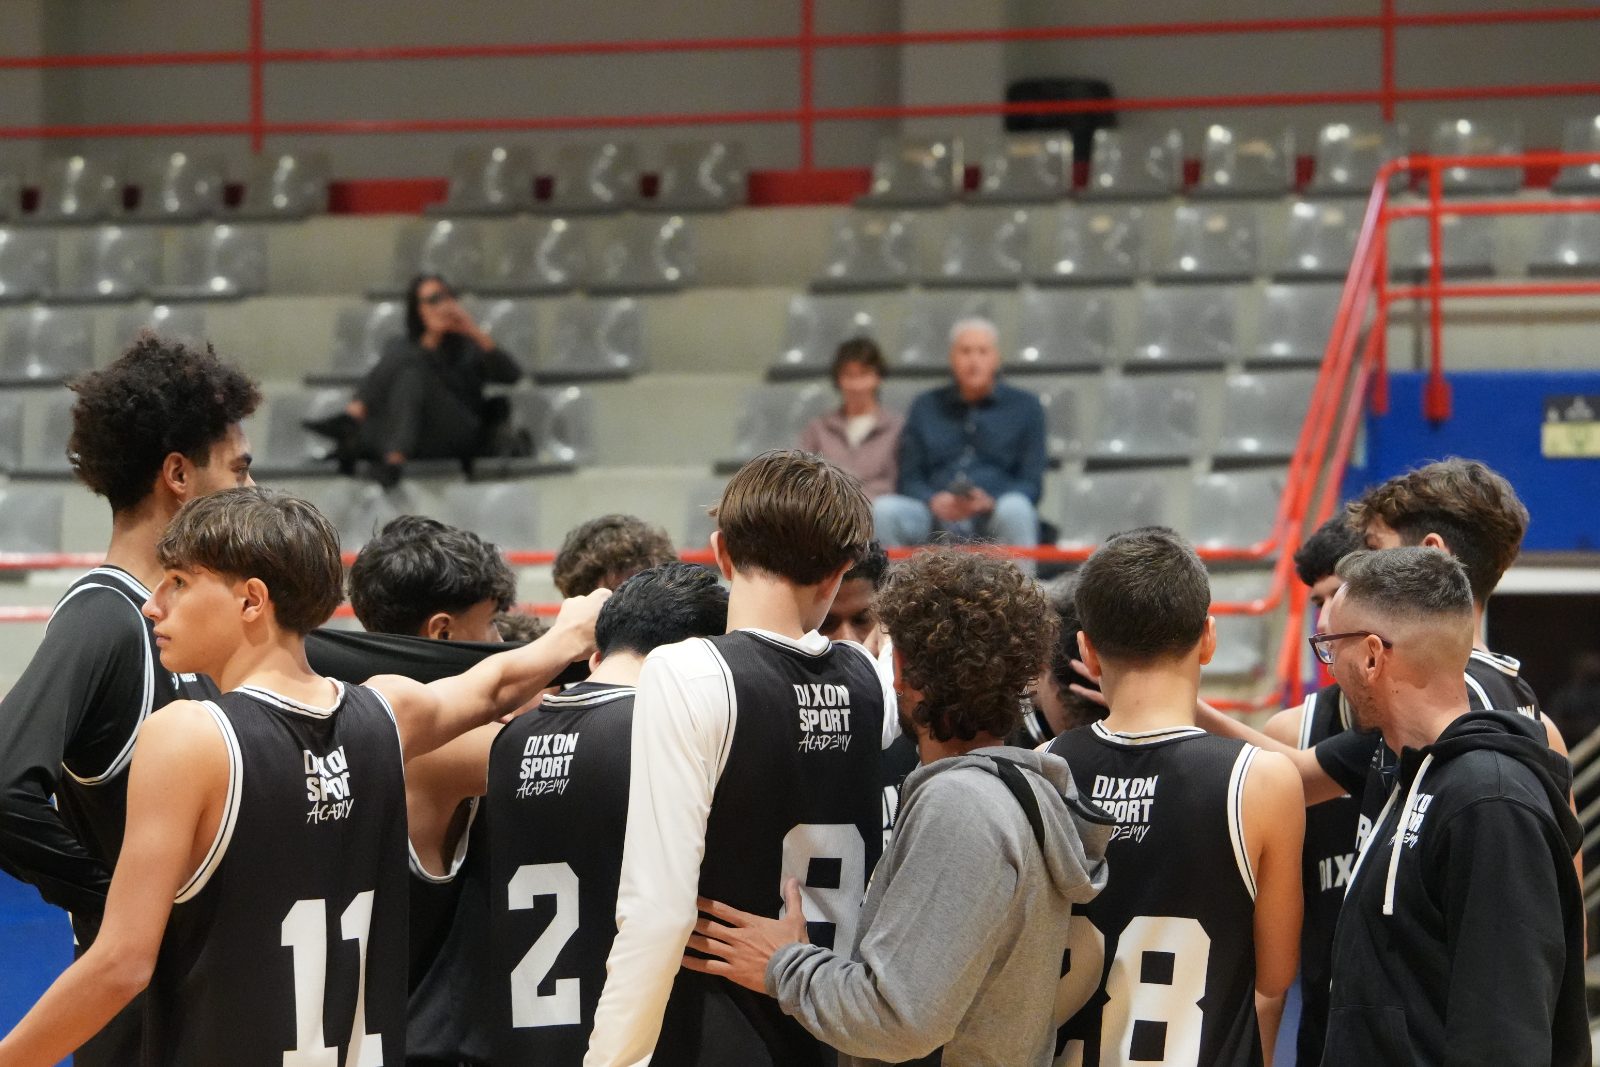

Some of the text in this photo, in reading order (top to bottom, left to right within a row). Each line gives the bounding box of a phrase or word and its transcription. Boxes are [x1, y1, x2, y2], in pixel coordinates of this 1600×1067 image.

[793, 684, 850, 706] DIXON
[799, 708, 851, 732] SPORT
[523, 732, 580, 756] DIXON
[798, 732, 852, 753] ACADEMY
[303, 745, 349, 777] DXO
[519, 755, 574, 779] SPORT
[306, 771, 351, 802] SPOT
[516, 778, 570, 799] ACADEMY
[1091, 774, 1159, 800] DIXON
[306, 798, 355, 824] ACADY
[1109, 825, 1151, 843] DEMY
[1319, 853, 1355, 892] DIX
[508, 862, 581, 1028] 2
[281, 889, 384, 1067] 11
